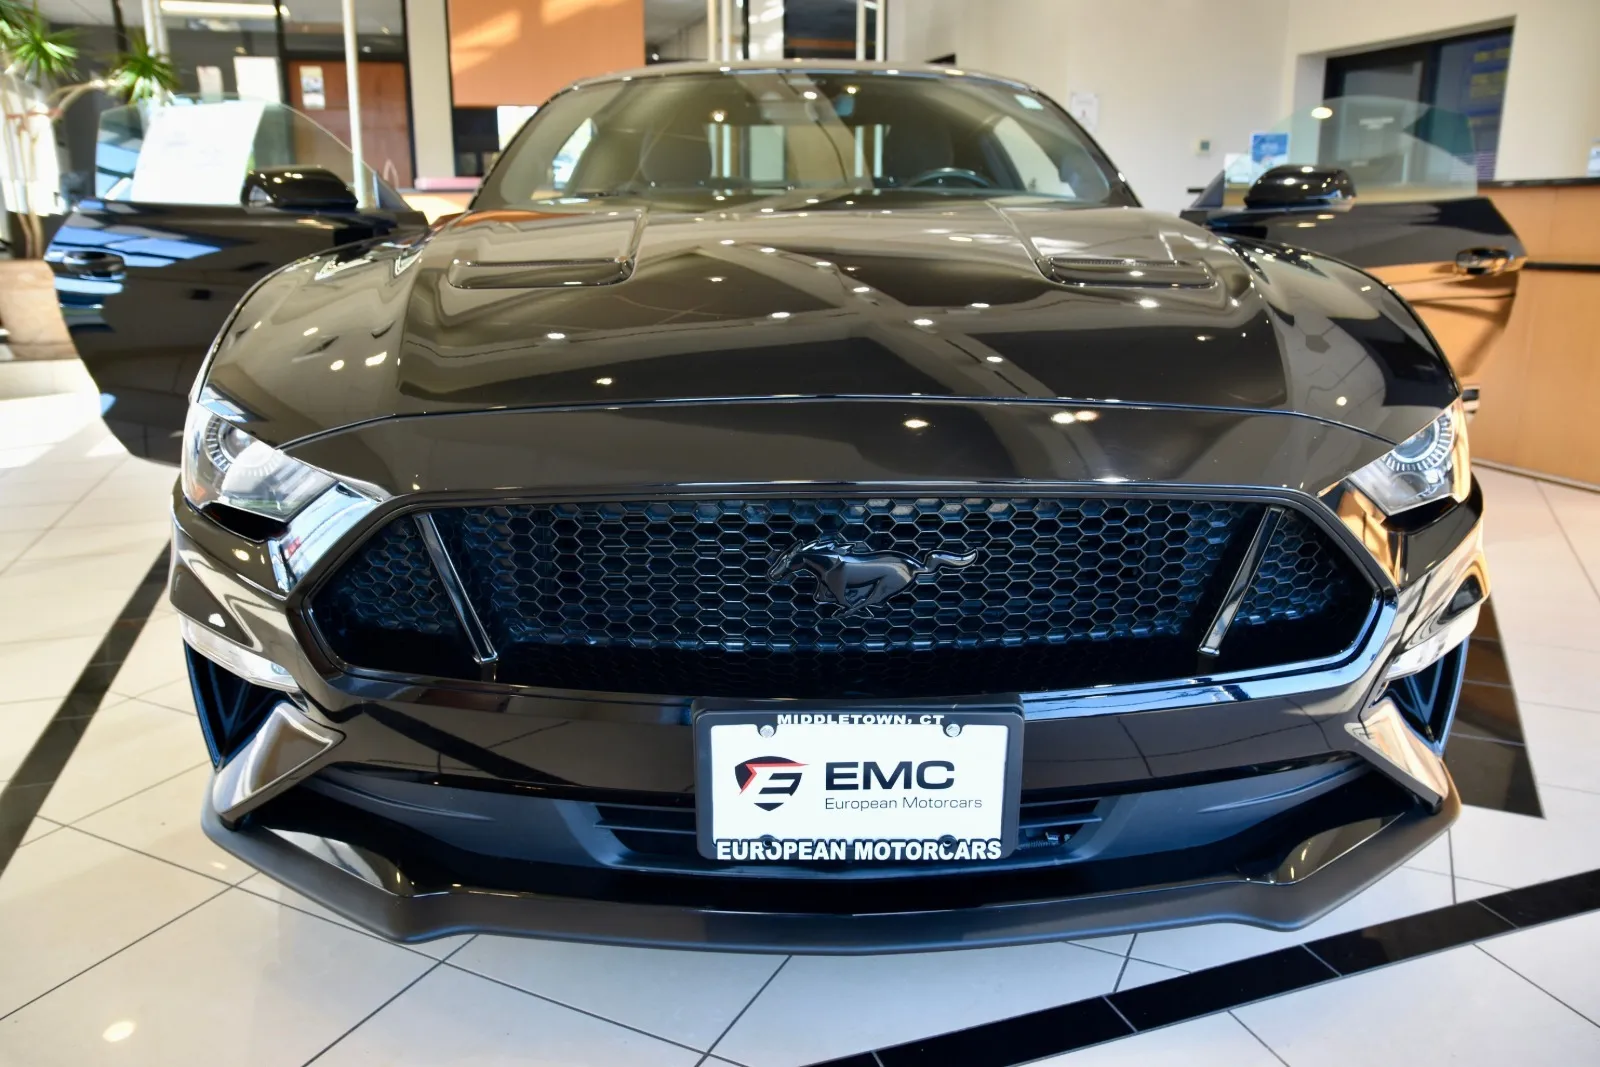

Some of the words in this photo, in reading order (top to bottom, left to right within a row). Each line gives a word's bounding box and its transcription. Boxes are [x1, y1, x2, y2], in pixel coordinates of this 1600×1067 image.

[777, 714, 912, 725] MIDDLETOWN,
[919, 714, 945, 725] CT
[825, 760, 955, 791] EMC
[825, 797, 898, 811] European
[902, 796, 983, 809] Motorcars
[716, 840, 847, 860] EUROPEAN
[854, 840, 1002, 860] MOTORCARS
